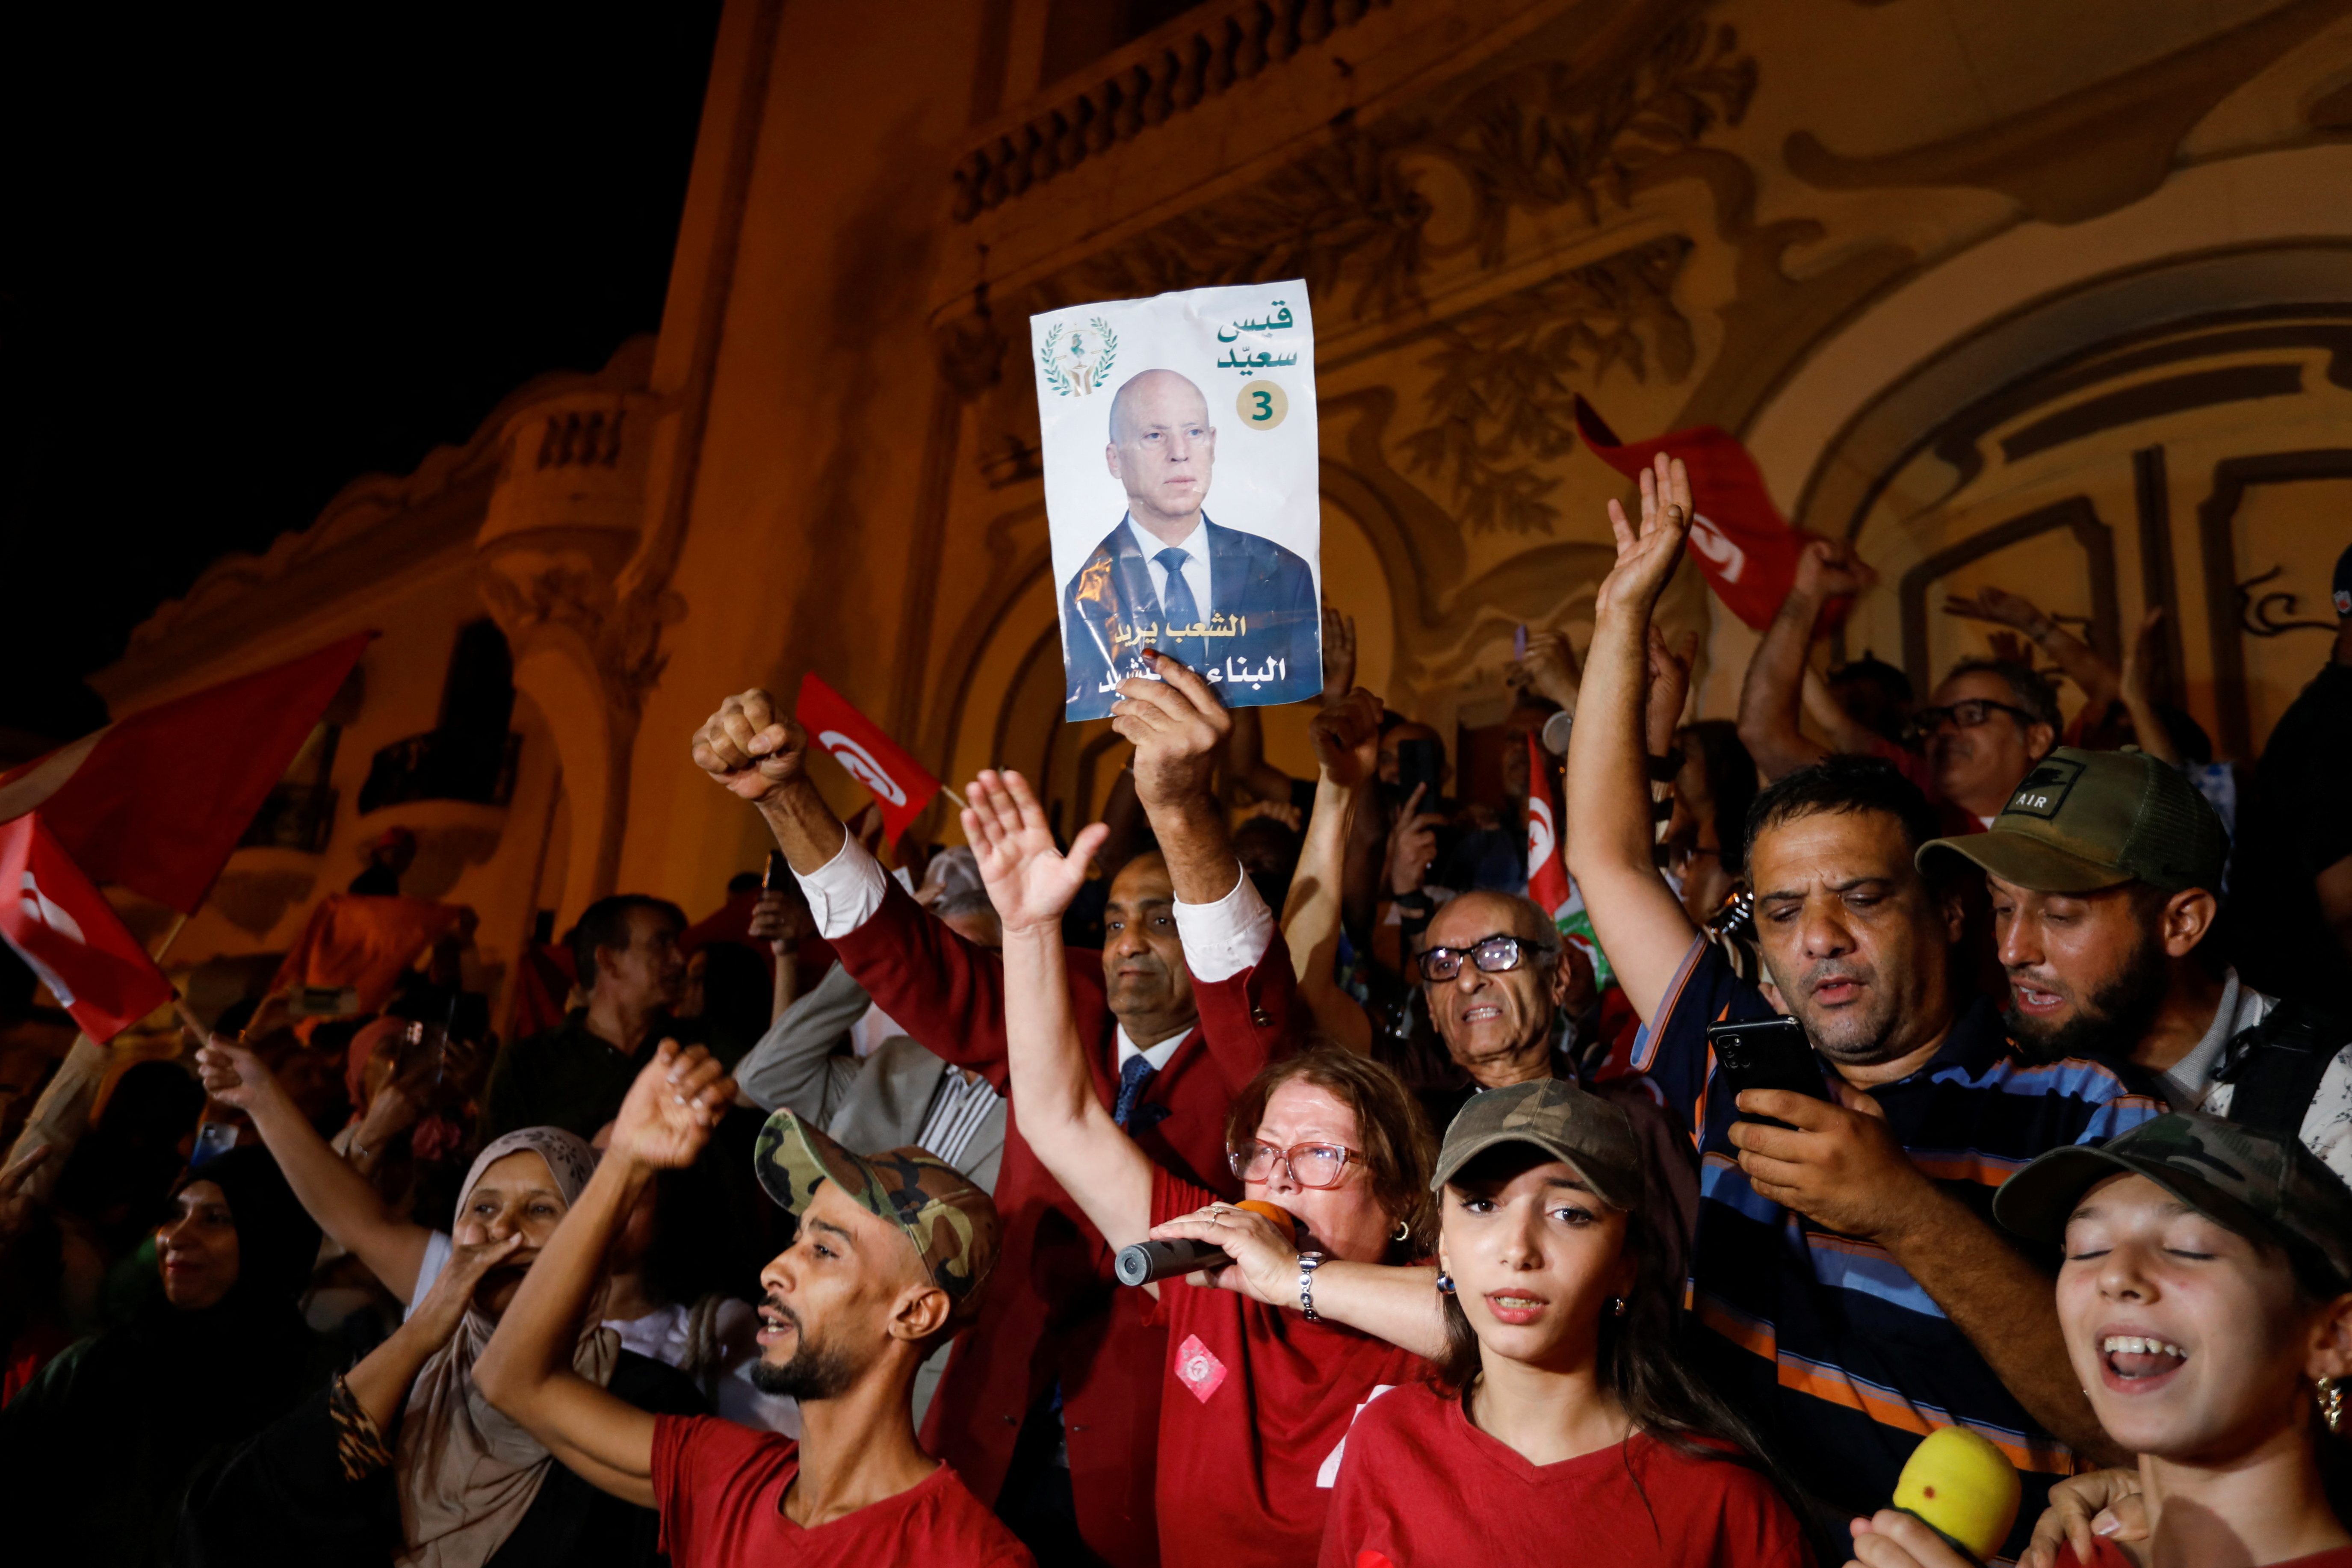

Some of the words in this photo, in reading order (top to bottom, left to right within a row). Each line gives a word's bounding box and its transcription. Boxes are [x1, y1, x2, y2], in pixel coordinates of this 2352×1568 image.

[1217, 300, 1293, 343] قيس
[1252, 390, 1273, 421] 3
[1114, 621, 1158, 647] يريد
[1165, 612, 1247, 643] الشعب
[1206, 656, 1286, 691] البناء
[2015, 793, 2048, 808] AIR
